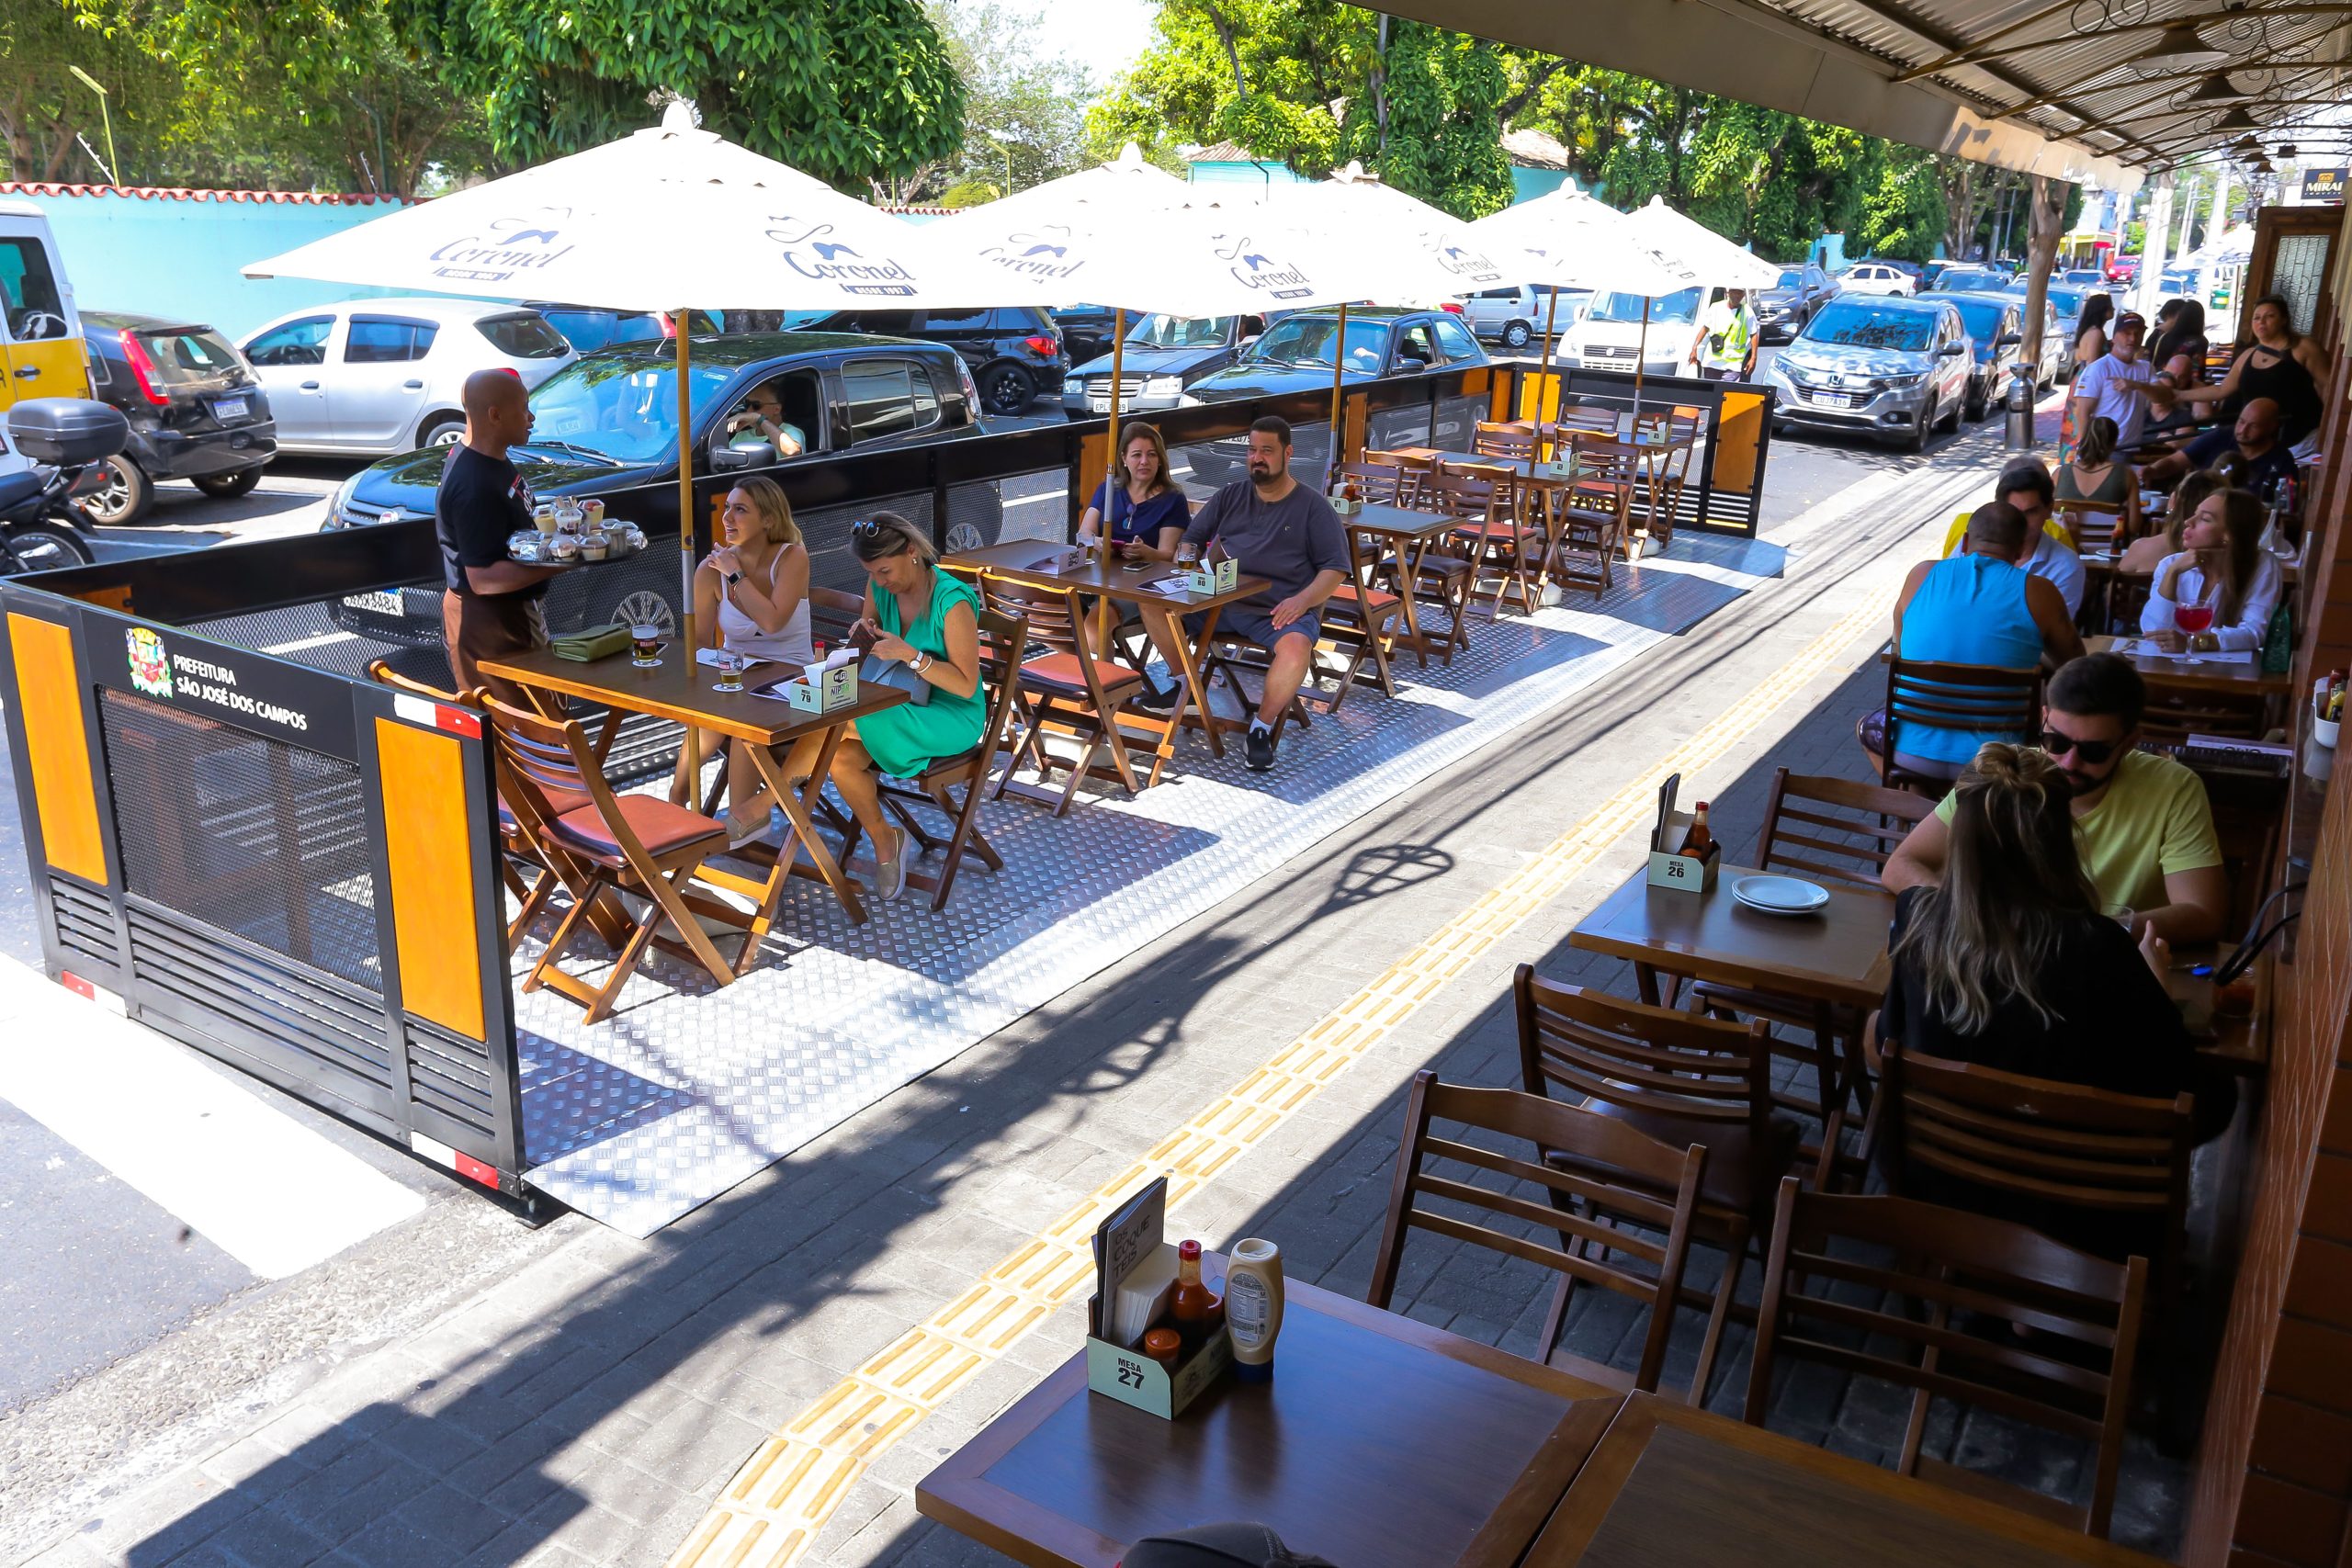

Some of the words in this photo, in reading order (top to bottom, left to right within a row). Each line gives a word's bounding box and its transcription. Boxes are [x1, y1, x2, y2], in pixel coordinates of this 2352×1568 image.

[430, 236, 575, 268] Coronel
[1437, 254, 1498, 275] Coronel
[784, 251, 917, 281] Coronel
[1231, 263, 1310, 288] Coronel
[173, 653, 237, 686] PREFEITURA
[175, 675, 200, 697] SÃO
[201, 683, 229, 706] JOSÉ
[229, 692, 255, 715] DOS
[255, 701, 308, 731] CAMPOS
[801, 694, 811, 703] 79
[1668, 866, 1685, 878] 26
[1114, 1214, 1150, 1261] COQUE
[1115, 1227, 1128, 1246] OS
[1114, 1249, 1137, 1279] TEIS
[1118, 1358, 1142, 1373] MESA
[1117, 1367, 1145, 1390] 27
